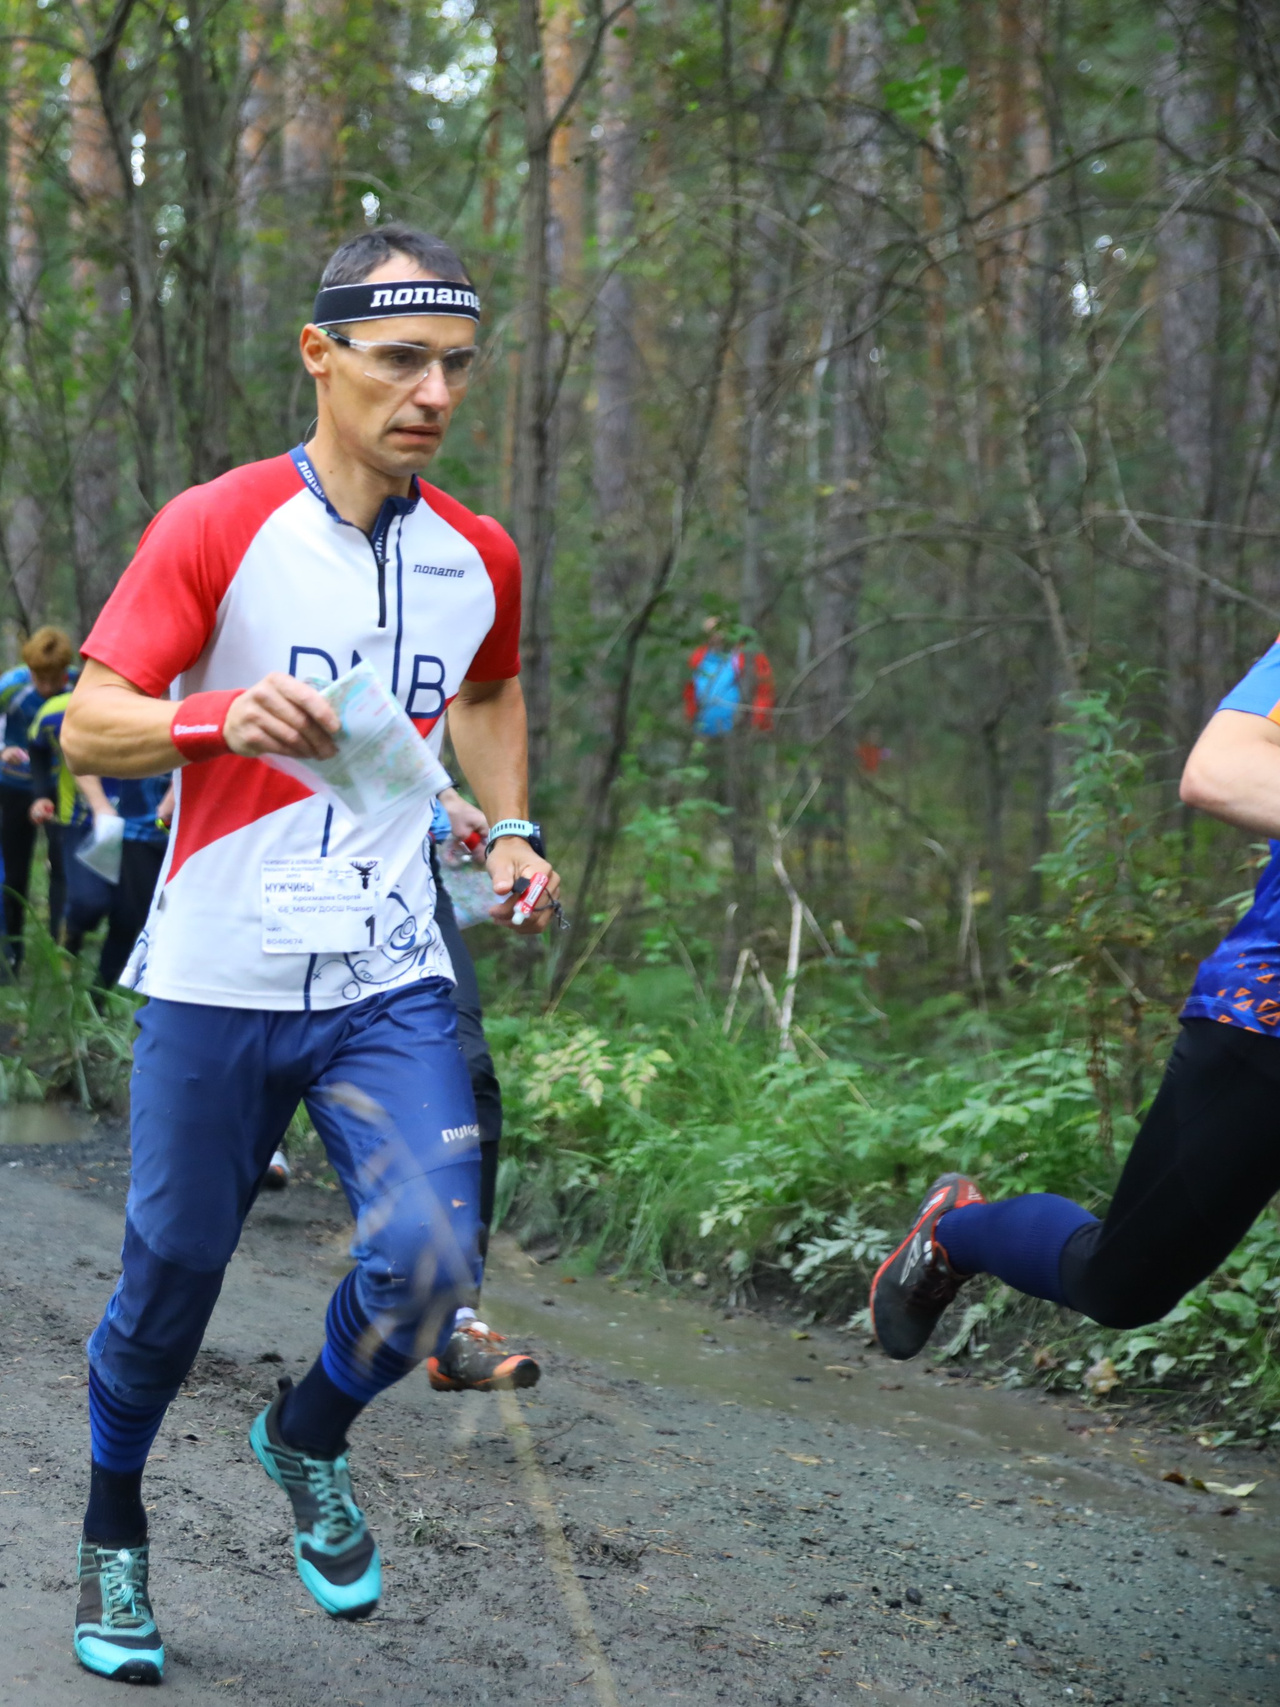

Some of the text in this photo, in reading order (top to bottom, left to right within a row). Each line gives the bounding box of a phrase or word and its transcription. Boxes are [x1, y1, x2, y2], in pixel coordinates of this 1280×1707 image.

[413, 564, 465, 578] noname
[265, 883, 315, 892] МУЖЧИНЫ
[365, 914, 377, 947] 1
